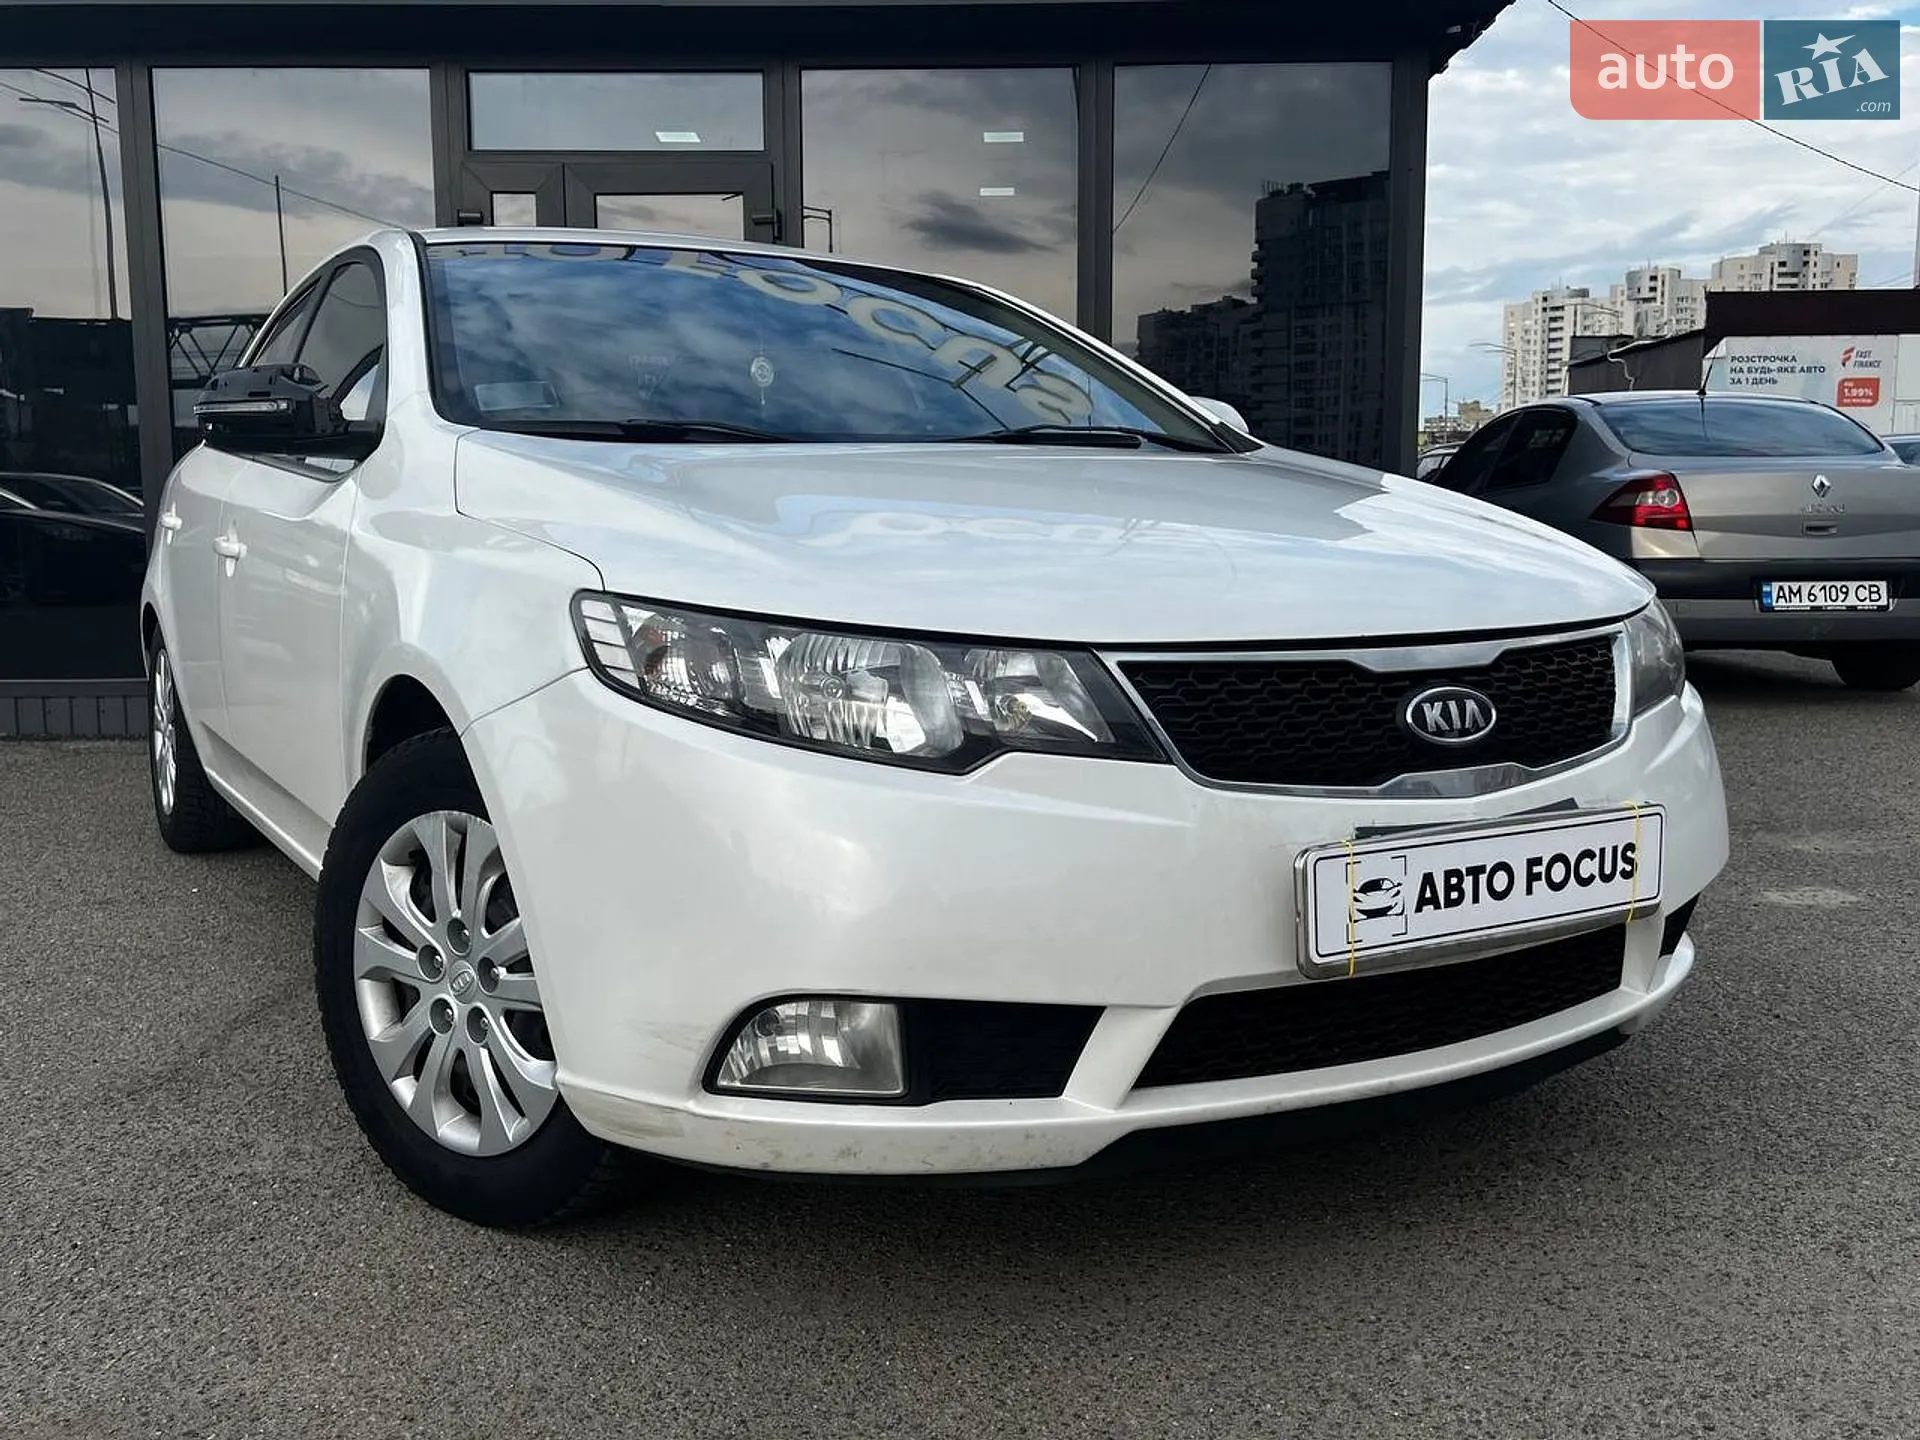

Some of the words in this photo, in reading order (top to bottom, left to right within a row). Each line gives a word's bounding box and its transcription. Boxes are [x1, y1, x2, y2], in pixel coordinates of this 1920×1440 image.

[1730, 355, 1797, 363] РОЗСТРОЧКА
[1729, 366, 1744, 374] НА
[1747, 366, 1796, 375] БУДЬ-ЯКЕ
[1799, 365, 1826, 374] АВТО
[1751, 377, 1778, 385] ДЕНЬ
[1775, 584, 1802, 604] AM
[1807, 584, 1849, 603] 6109
[1855, 584, 1882, 603] CB
[1421, 699, 1485, 732] KIA
[1414, 862, 1515, 914] АВТО
[1525, 842, 1636, 896] FOCUS
